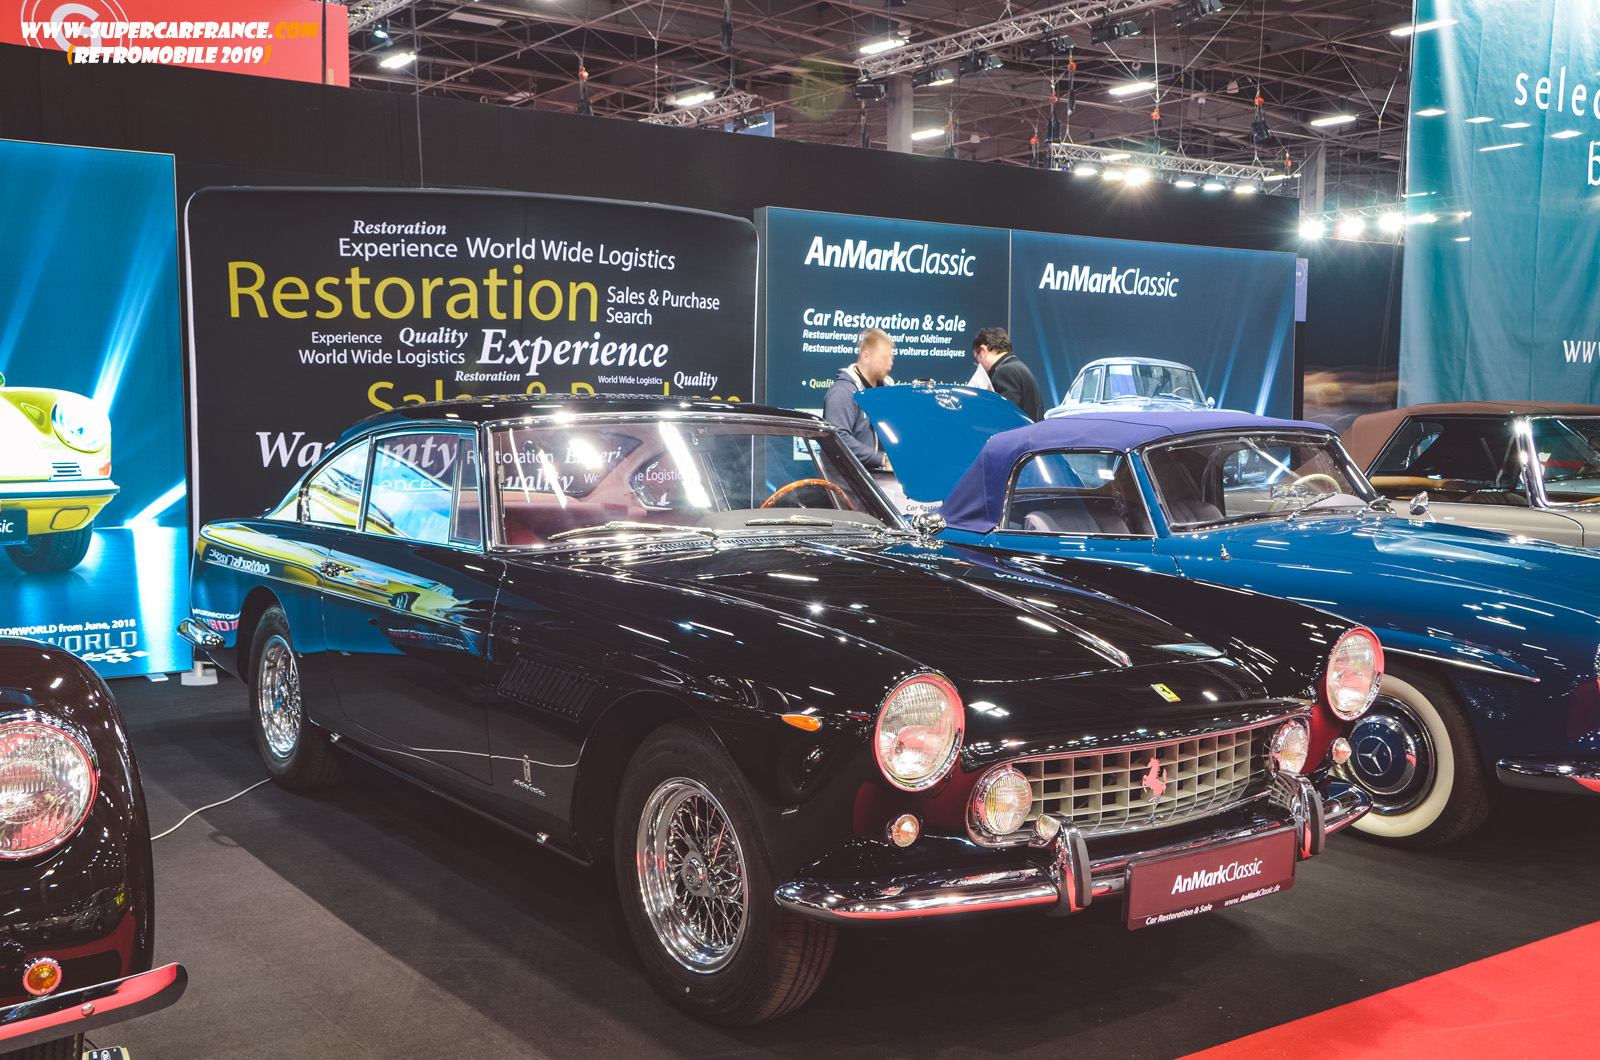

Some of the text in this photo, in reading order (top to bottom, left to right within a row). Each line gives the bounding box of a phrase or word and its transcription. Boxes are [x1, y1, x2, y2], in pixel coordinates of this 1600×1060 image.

[352, 220, 447, 235] Restoration
[338, 236, 676, 271] Experience World Wide Logistics
[804, 236, 976, 277] AnMarkClassic
[1039, 262, 1180, 298] AnMarkClassic
[228, 261, 598, 322] Restoration
[606, 286, 720, 311] Sales & Purchase
[606, 307, 652, 325] Search
[803, 308, 967, 332] Car Restoration & Sale
[311, 327, 468, 348] Experience Quality
[802, 329, 858, 343] Restaurierung
[905, 335, 919, 343] von
[920, 334, 952, 344] Oldtimer
[299, 349, 465, 368] World Wide Logistics
[476, 328, 669, 377] Experience
[802, 342, 853, 355] Restauration
[899, 347, 929, 357] voitures
[930, 348, 966, 359] classiques
[1563, 339, 1600, 364] ww
[455, 370, 521, 382] Restoration
[598, 375, 663, 387] World Wide Logistics
[673, 371, 718, 390] Quality
[58, 623, 83, 632] from
[84, 621, 111, 631] June,
[111, 618, 136, 628] 2018
[1171, 857, 1263, 895] AnMarkClassic
[1145, 916, 1158, 926] Car
[1157, 908, 1194, 923] Restoration
[1193, 906, 1200, 914] &
[1199, 903, 1213, 913] Sale
